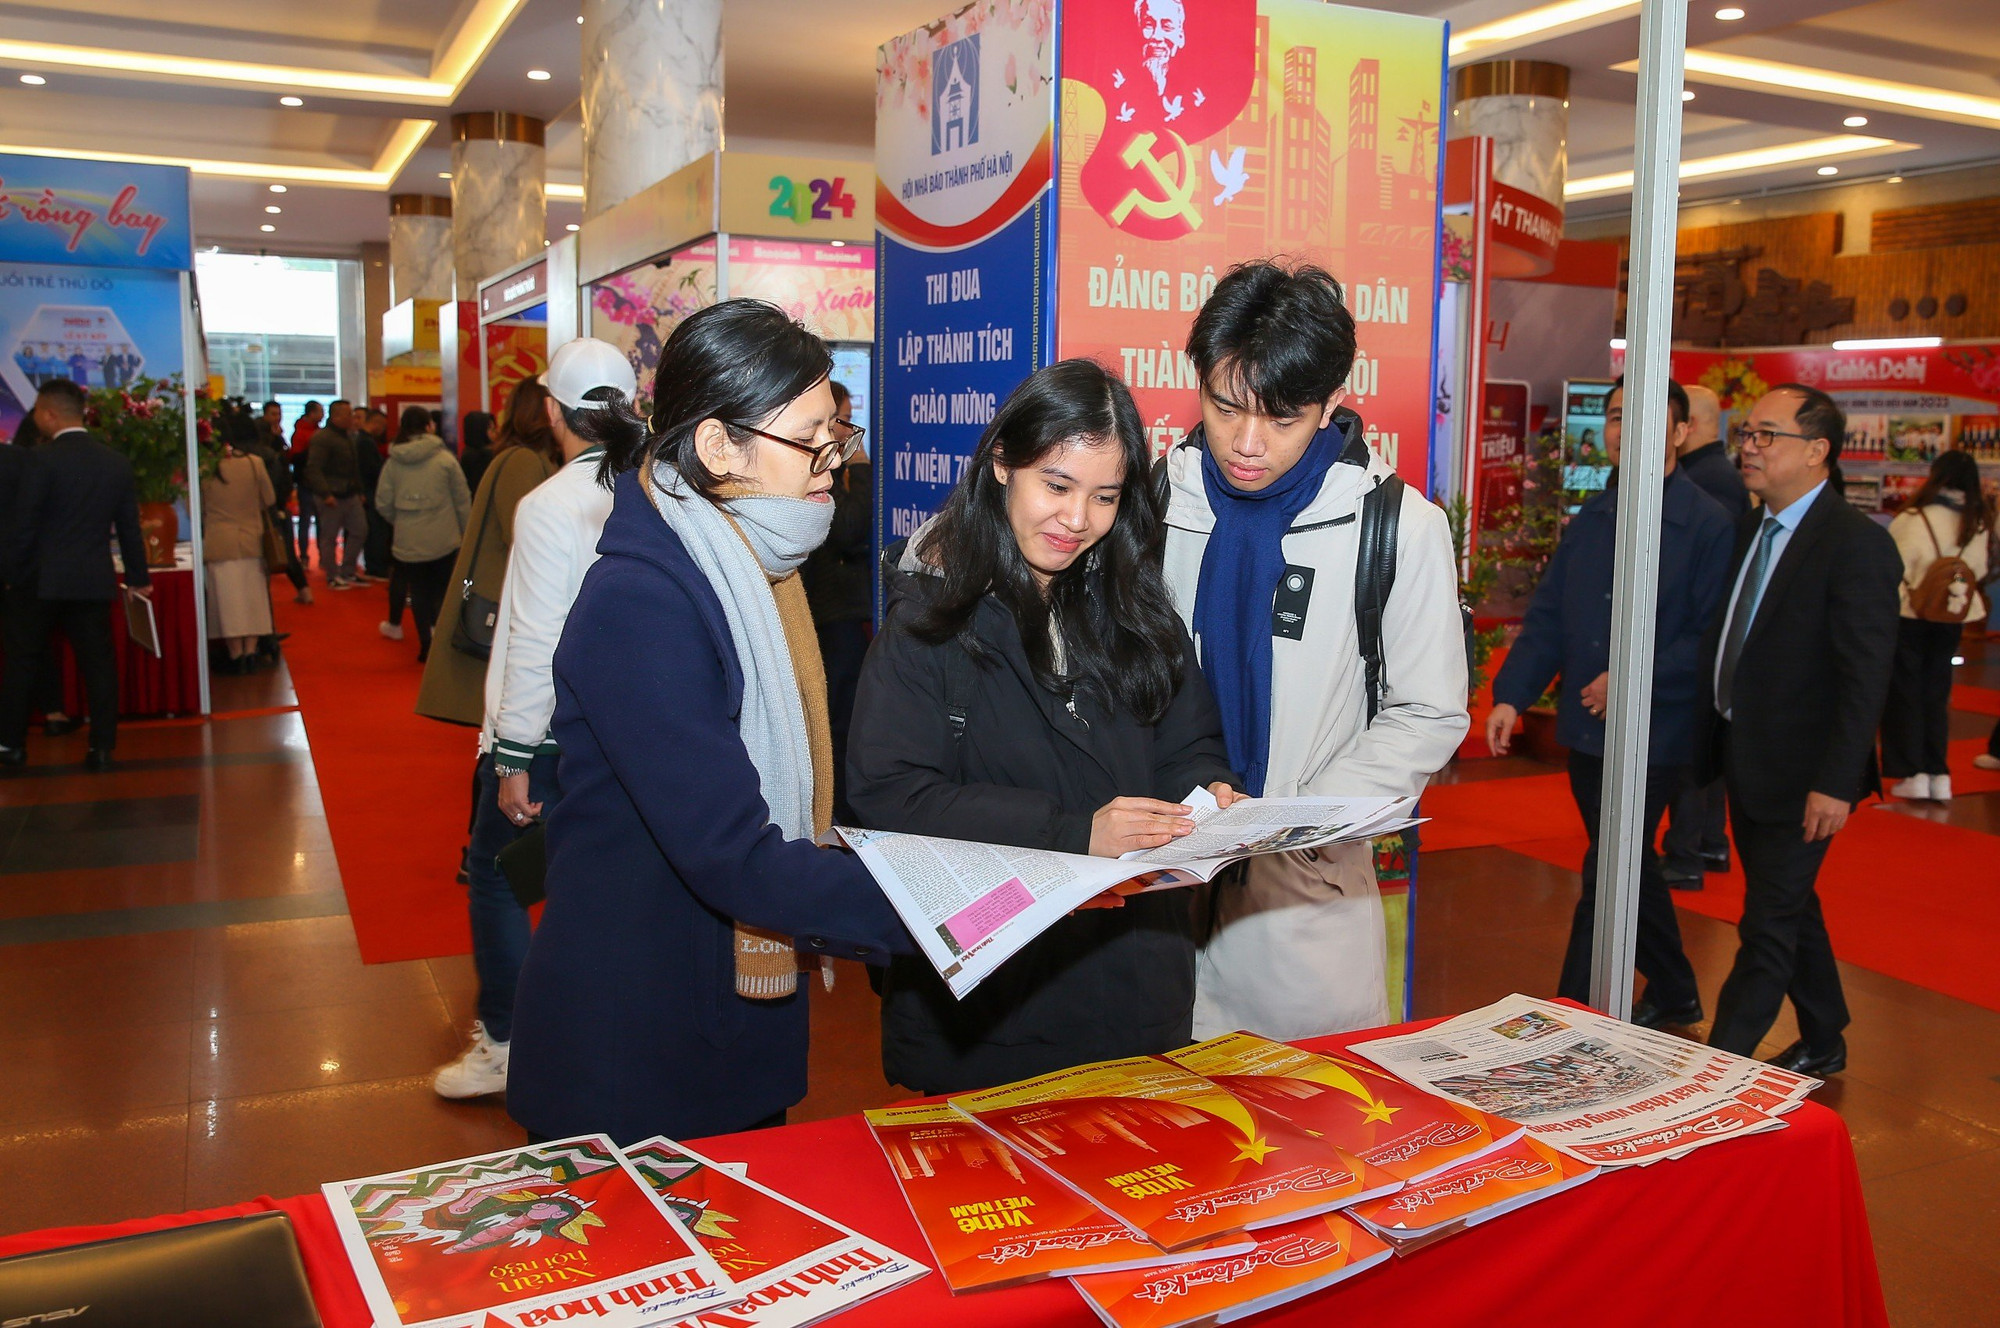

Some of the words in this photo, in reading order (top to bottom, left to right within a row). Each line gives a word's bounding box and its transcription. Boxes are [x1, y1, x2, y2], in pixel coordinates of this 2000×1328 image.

[902, 178, 914, 202] HỘI
[914, 175, 928, 196] NHÀ
[929, 172, 943, 194] BÁO
[945, 165, 970, 188] THÀNH
[970, 155, 986, 182] PHỐ
[986, 155, 998, 177] HÀ
[1000, 150, 1013, 177] NỘI
[768, 175, 856, 224] 2024
[21, 188, 97, 252] rồng
[107, 185, 168, 255] bay
[926, 272, 948, 305] THI
[951, 268, 981, 303] ĐUA
[1088, 254, 1170, 311] ĐẢNG
[1355, 277, 1409, 325] DÂN
[898, 330, 923, 372] LẬP
[926, 326, 974, 364] THÀNH
[977, 322, 1013, 363] TÍCH
[1120, 341, 1201, 390] THÀN
[1347, 350, 1379, 404] ỘI
[910, 387, 947, 424] CHÀO
[950, 386, 996, 425] MỪNG
[895, 442, 912, 480] KỶ
[915, 447, 950, 490] NIỆM
[1626, 1094, 1678, 1114] khẩu
[1666, 1082, 1714, 1102] Xuất
[1526, 1120, 1573, 1134] tăng
[1563, 1118, 1592, 1130] đà
[1583, 1108, 1634, 1126] vùng
[1104, 1169, 1142, 1188] NAM
[1142, 1162, 1183, 1179] VIỆT
[995, 1196, 1036, 1211] VIỆT
[1122, 1178, 1167, 1200] thế
[949, 1200, 992, 1218] NAM
[956, 1216, 1002, 1235] thế
[489, 1260, 538, 1279] ngộ
[544, 1250, 588, 1271] hội
[791, 1246, 893, 1285] Tinh
[496, 1264, 596, 1294] Xuân
[604, 1267, 715, 1309] Tinh
[516, 1294, 609, 1328] hoa
[728, 1278, 810, 1316] hoa
